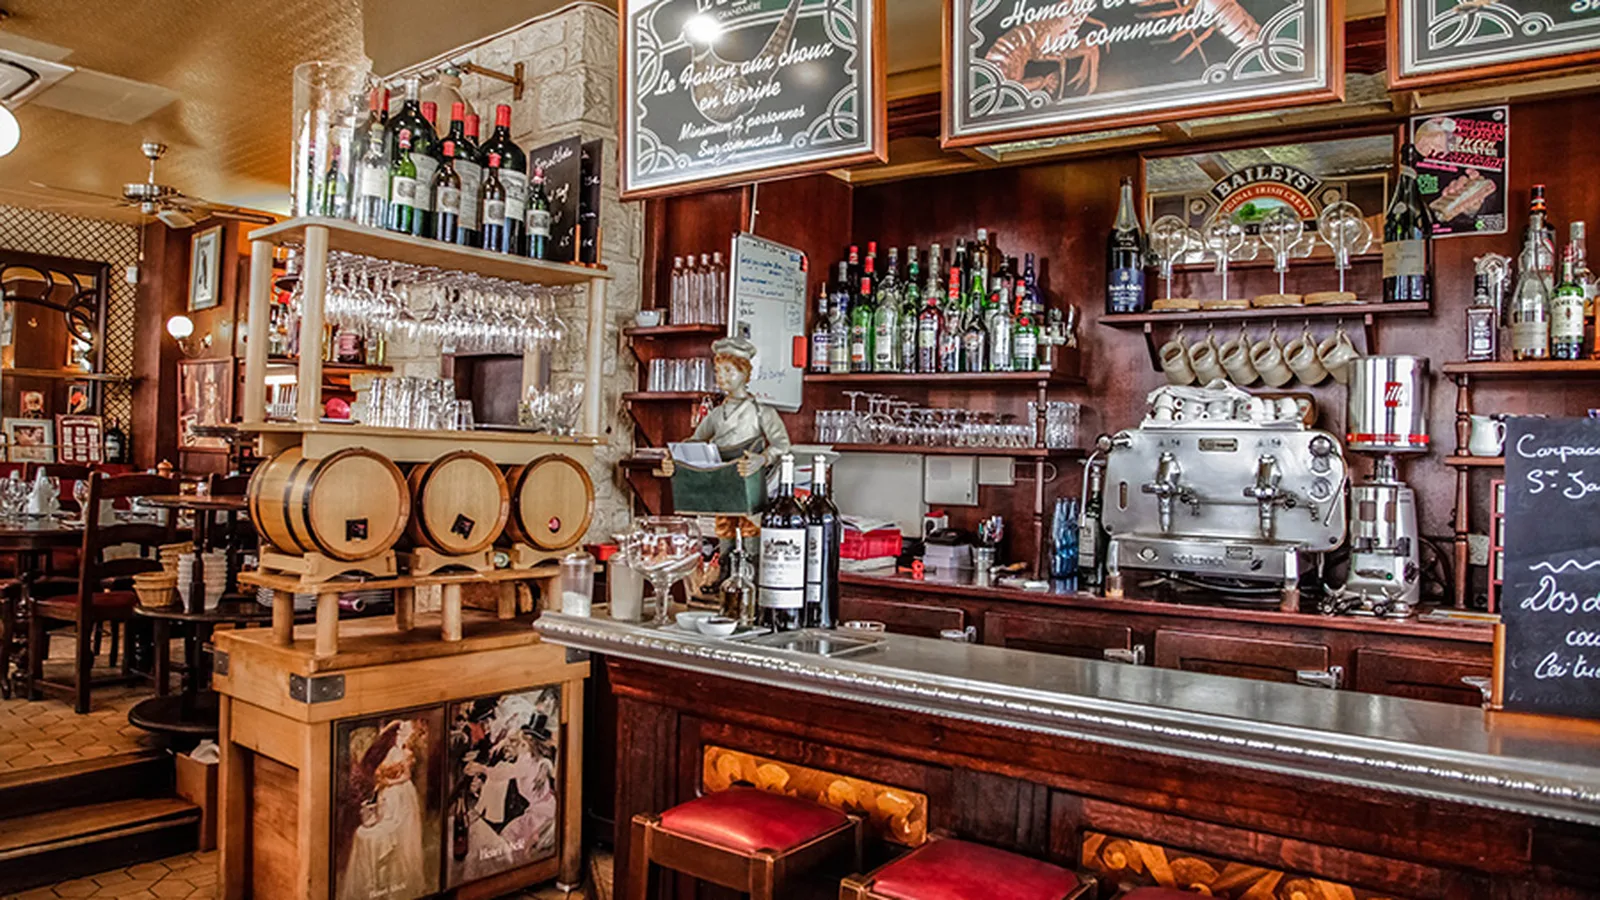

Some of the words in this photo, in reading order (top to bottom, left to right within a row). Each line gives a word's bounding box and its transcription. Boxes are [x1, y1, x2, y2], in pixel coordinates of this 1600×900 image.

[1040, 28, 1081, 54] sur
[1085, 3, 1221, 46] commande
[654, 69, 676, 96] Le
[680, 63, 738, 91] Faisan
[739, 55, 776, 74] aux
[778, 38, 835, 67] choux
[699, 95, 722, 112] en
[723, 79, 782, 107] terrine
[678, 119, 734, 142] Minimum
[734, 115, 744, 134] 2
[744, 104, 806, 133] personnes
[722, 126, 783, 152] commande
[1217, 166, 1311, 198] BAILEYS
[1255, 186, 1283, 196] IRISH
[1284, 191, 1311, 217] CREAM
[1520, 575, 1579, 614] Dos
